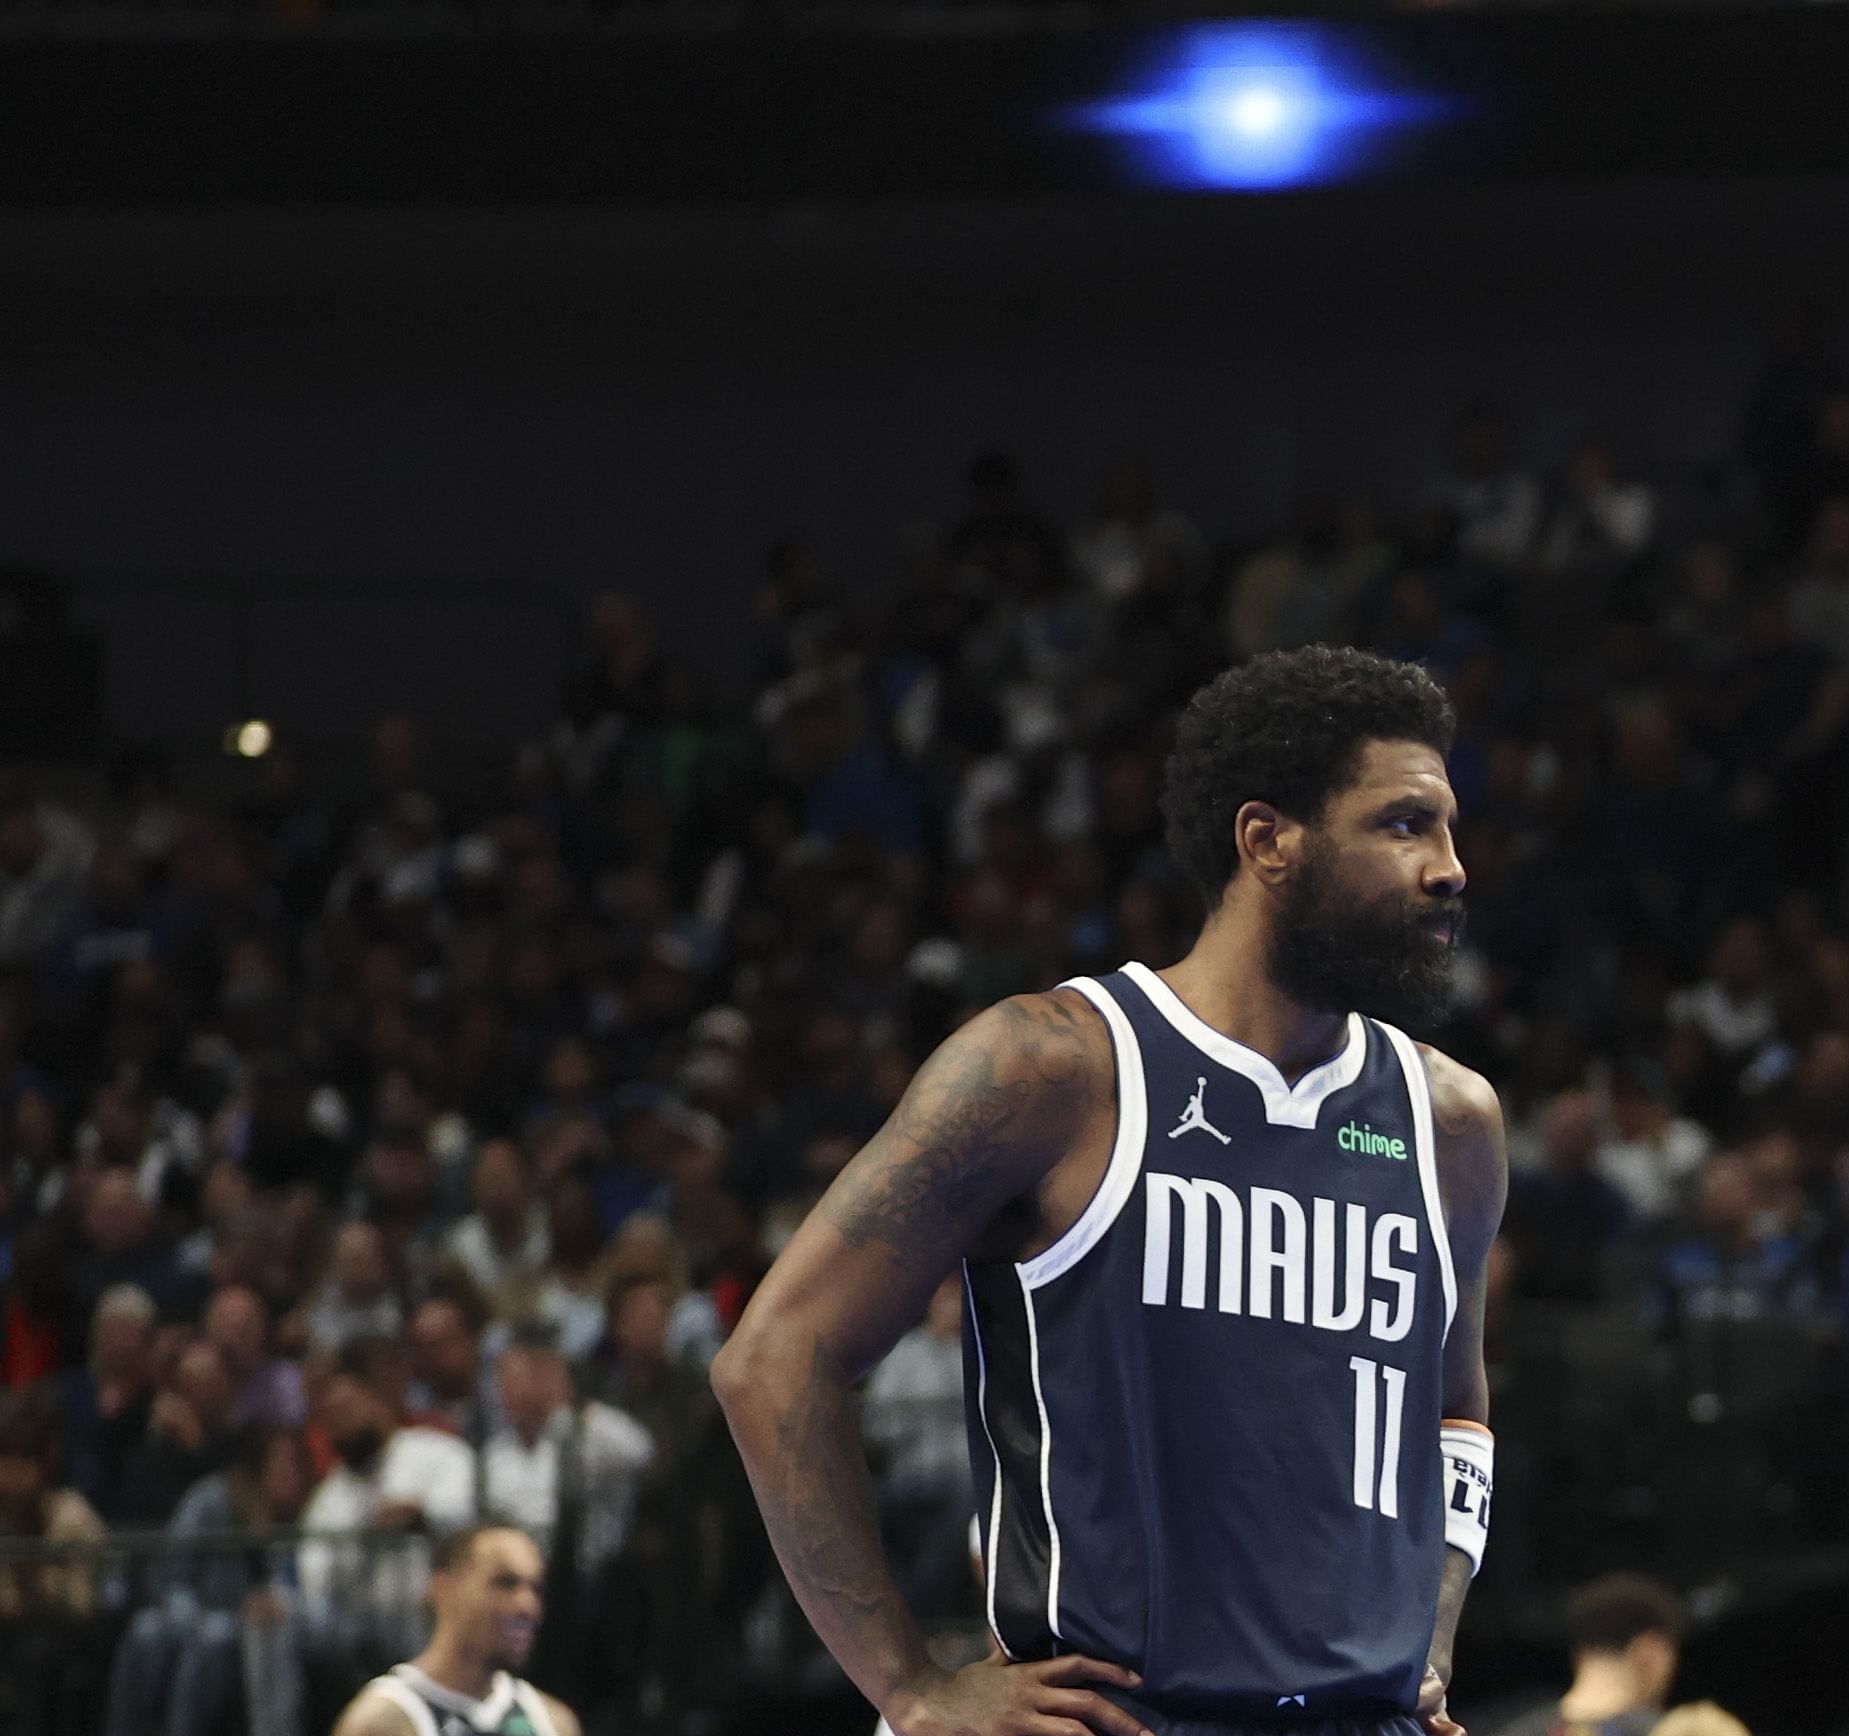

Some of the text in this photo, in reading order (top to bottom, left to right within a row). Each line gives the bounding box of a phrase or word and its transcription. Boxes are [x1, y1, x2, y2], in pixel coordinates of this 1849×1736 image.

[1337, 1120, 1408, 1160] chime
[1142, 1172, 1418, 1342] MAVS
[1349, 1355, 1407, 1519] 11
